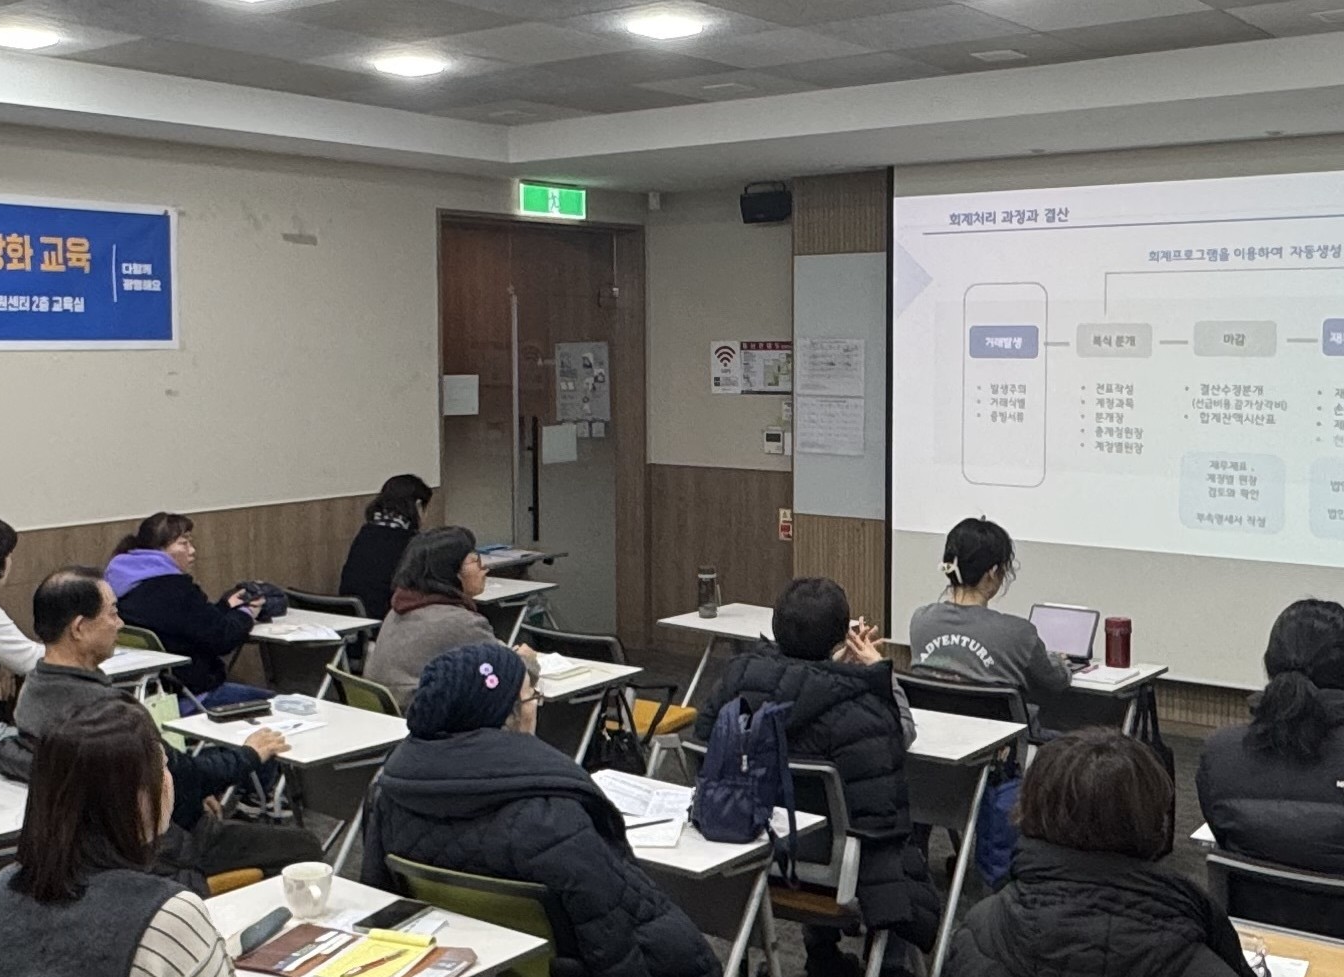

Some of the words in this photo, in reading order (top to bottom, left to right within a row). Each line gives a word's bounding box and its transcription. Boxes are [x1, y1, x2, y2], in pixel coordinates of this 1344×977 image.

[948, 211, 997, 227] 회계처리
[1001, 209, 1039, 225] 과정과
[1043, 207, 1069, 224] 결산
[39, 235, 92, 274] 교육
[1148, 248, 1229, 263] 회계프로그램을
[1233, 245, 1283, 261] 이용하여
[1289, 243, 1343, 260] 자동생성
[32, 295, 50, 312] 2층
[52, 296, 85, 313] 교육실
[984, 336, 1023, 349] 거래발생
[1092, 335, 1112, 348] 복식
[1115, 334, 1136, 347] 분개
[1223, 333, 1246, 346] 마감
[990, 383, 1027, 395] 발생주의
[1095, 382, 1134, 396] 전표작성
[1199, 383, 1265, 397] 결산수정분개
[1095, 397, 1135, 410] 계정과목
[1095, 412, 1125, 424] 분개장
[1199, 412, 1277, 426] 합계잔액시산표
[1095, 426, 1144, 440] 총계정원장
[1095, 441, 1144, 455] 계정별원장
[919, 634, 995, 668] ADVENTURE
